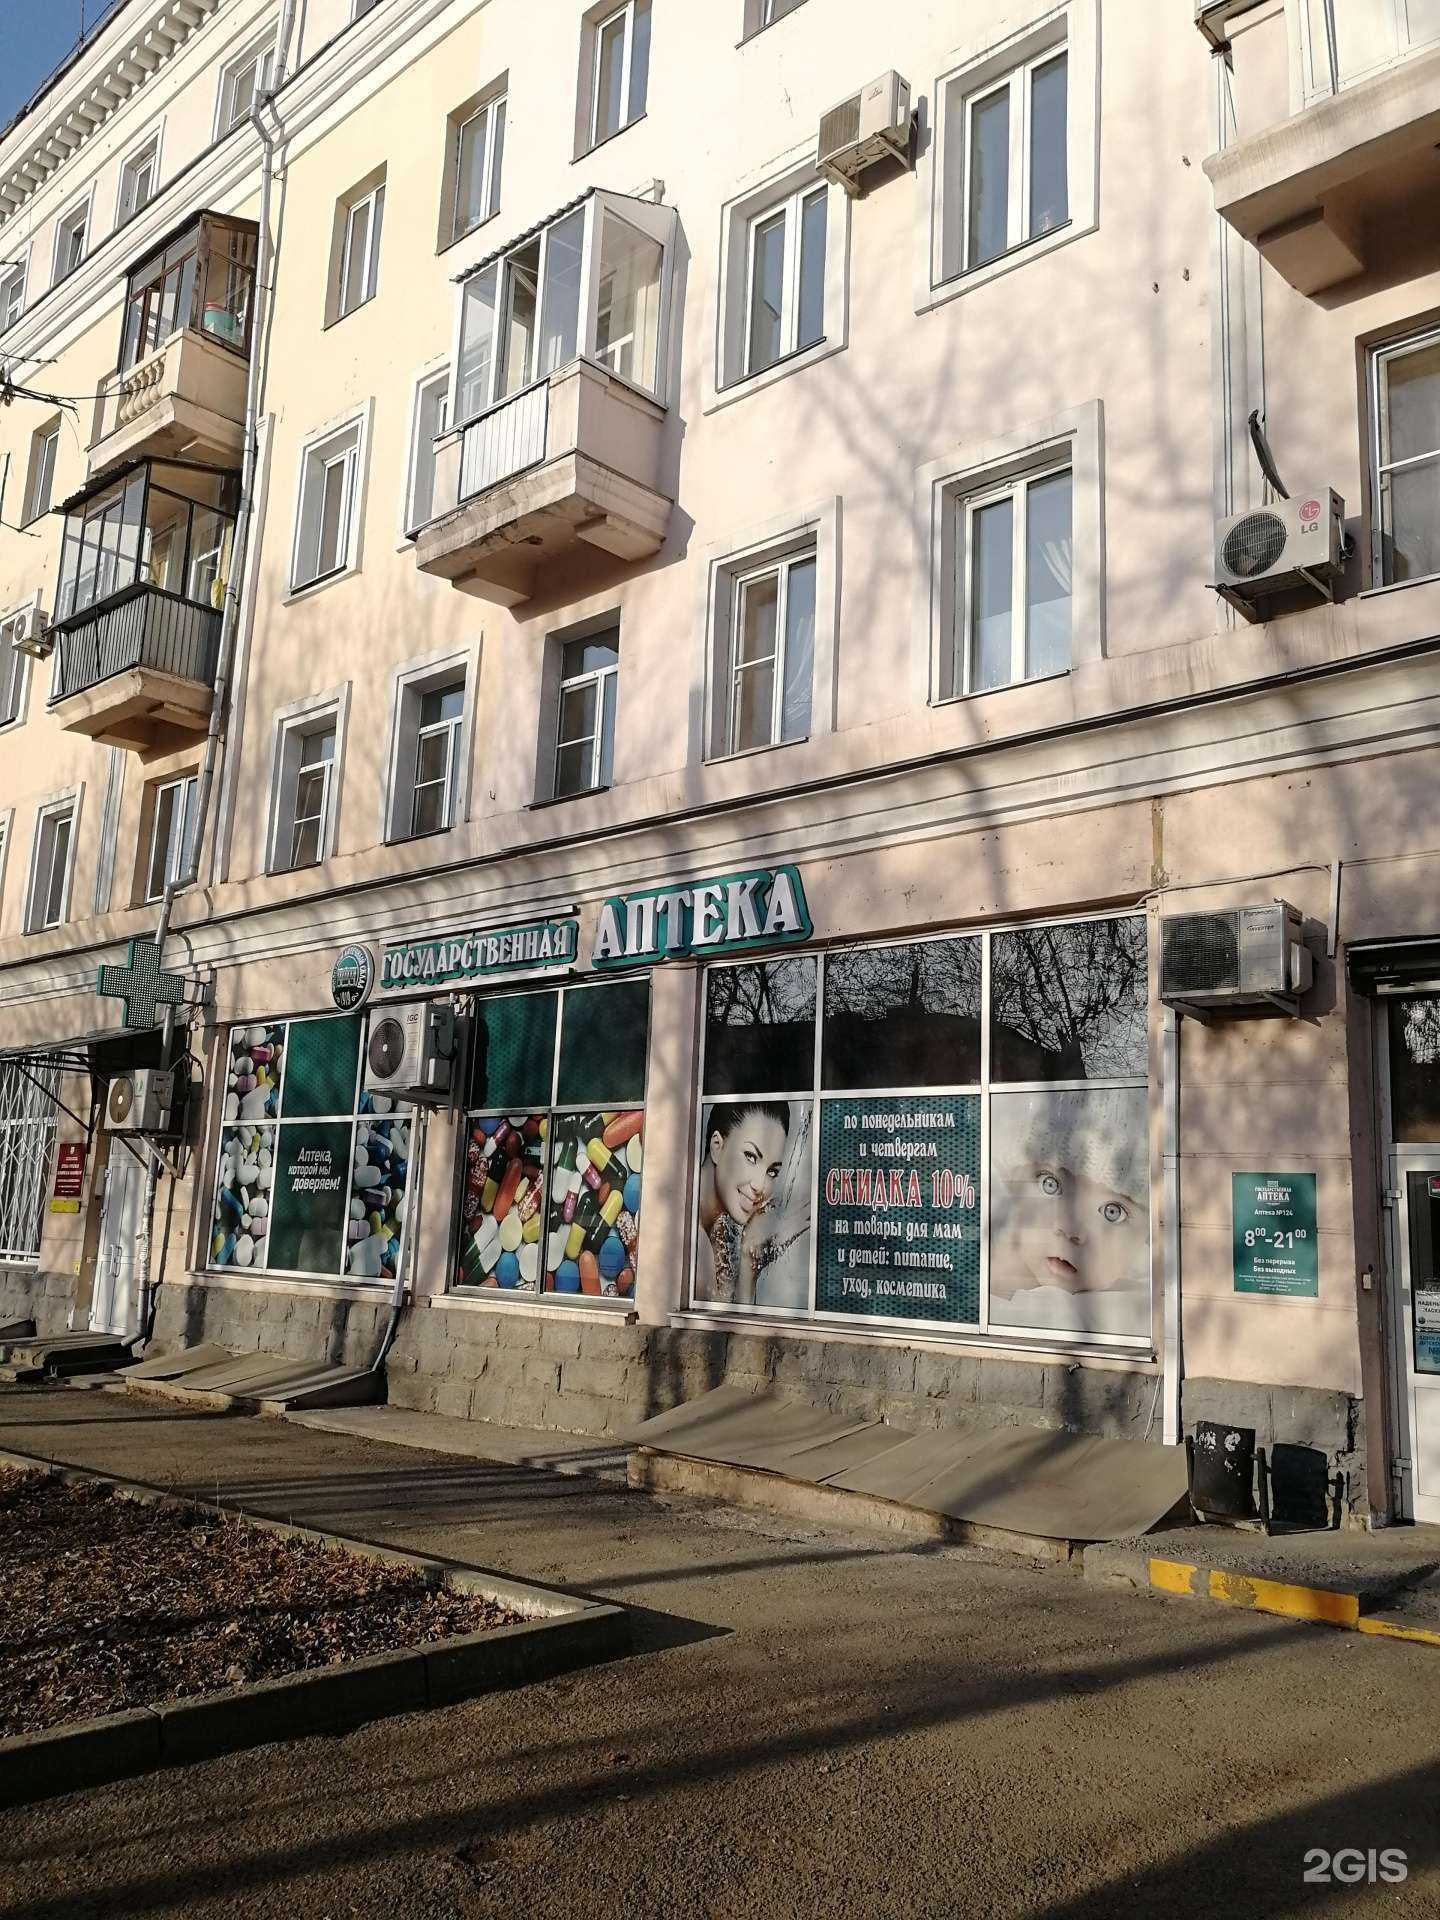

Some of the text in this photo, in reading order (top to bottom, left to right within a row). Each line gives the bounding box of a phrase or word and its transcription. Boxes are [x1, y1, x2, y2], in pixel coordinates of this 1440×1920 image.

[1301, 522, 1318, 534] LG
[591, 872, 802, 960] АПТЕКА
[381, 925, 569, 981] ГОСУДАРСТВЕННАЯ
[844, 1112, 955, 1133] по понедельникам
[297, 1147, 332, 1164] Аптека,
[859, 1137, 938, 1161] и четвергам
[288, 1163, 331, 1177] которой мы
[292, 1176, 341, 1193] доверяем!
[826, 1168, 975, 1211] СКИДКА 10%
[1257, 1192, 1290, 1201] АПТЕКА
[1254, 1208, 1275, 1216] Аптека
[835, 1215, 962, 1241] на товары для мам
[837, 1247, 953, 1271] и детей: питание,
[842, 1277, 946, 1299] уход, косметика
